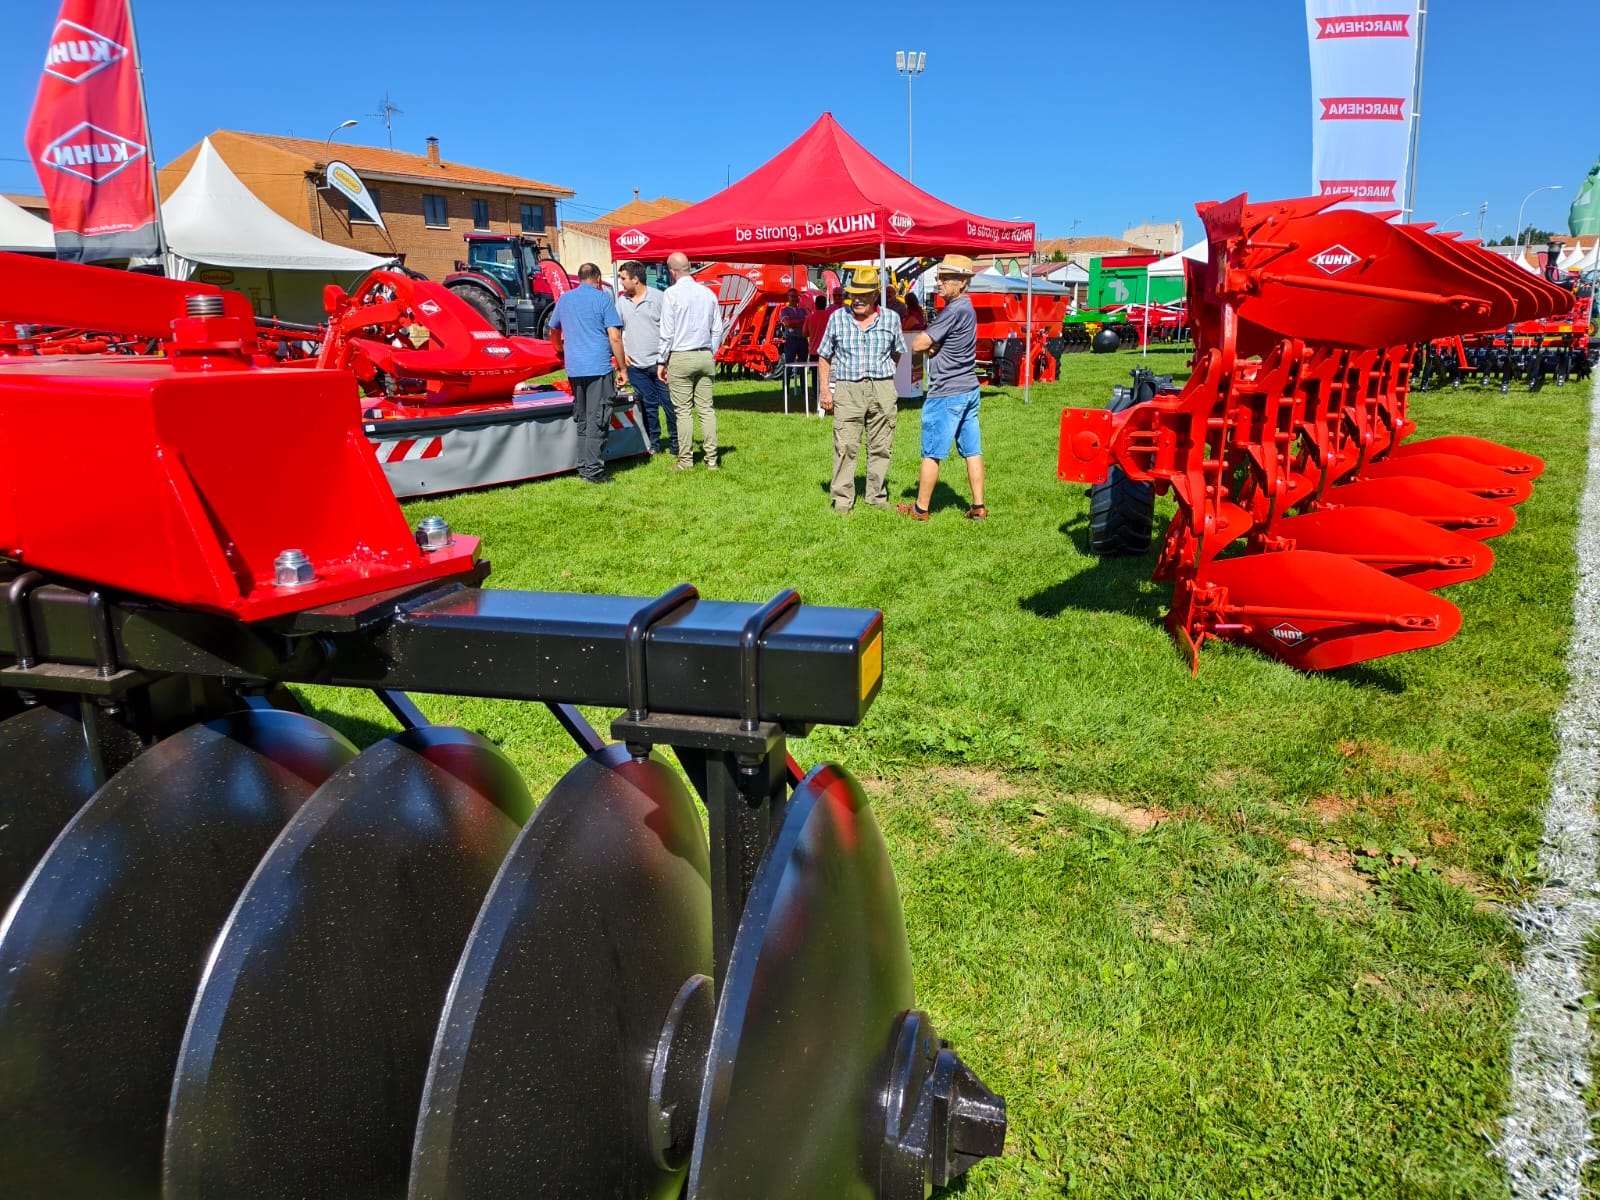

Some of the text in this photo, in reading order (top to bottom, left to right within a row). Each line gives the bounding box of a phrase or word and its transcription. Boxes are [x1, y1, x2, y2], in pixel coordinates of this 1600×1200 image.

[735, 212, 876, 242] be strong, be KUHN
[966, 220, 977, 236] be
[620, 235, 646, 246] KUHN
[1316, 254, 1353, 265] KUHN
[1272, 629, 1303, 640] KUHN
